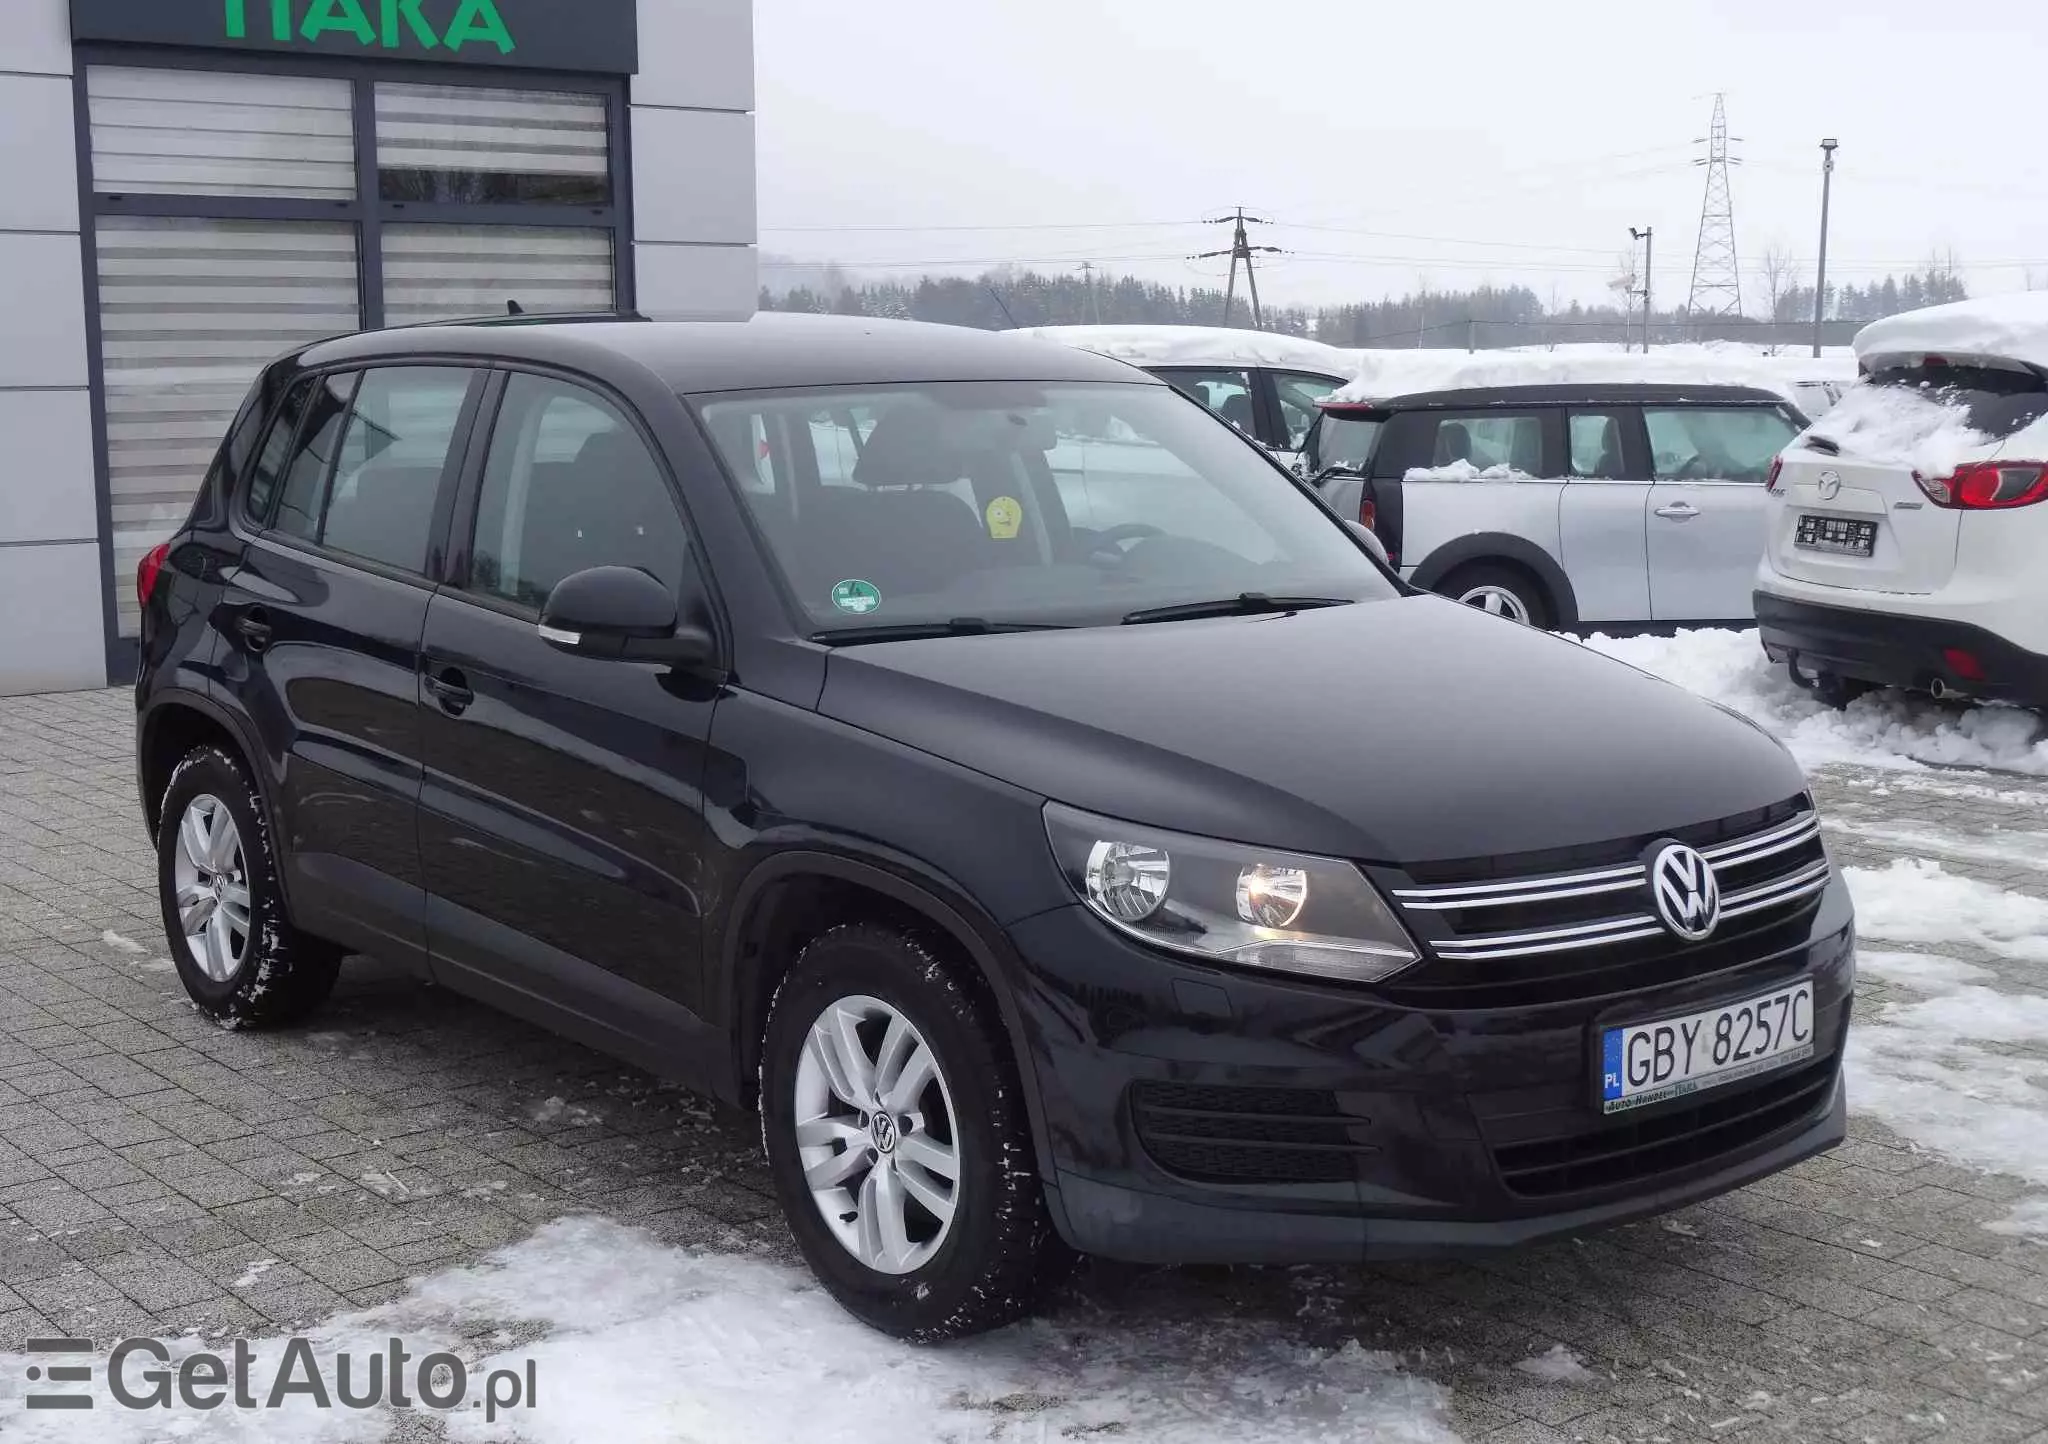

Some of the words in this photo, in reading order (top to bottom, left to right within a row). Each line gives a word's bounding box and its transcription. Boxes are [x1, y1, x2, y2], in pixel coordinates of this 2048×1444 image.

[1627, 1019, 1702, 1087] GBY
[1712, 990, 1808, 1065] 8257C
[1604, 1073, 1620, 1089] PL
